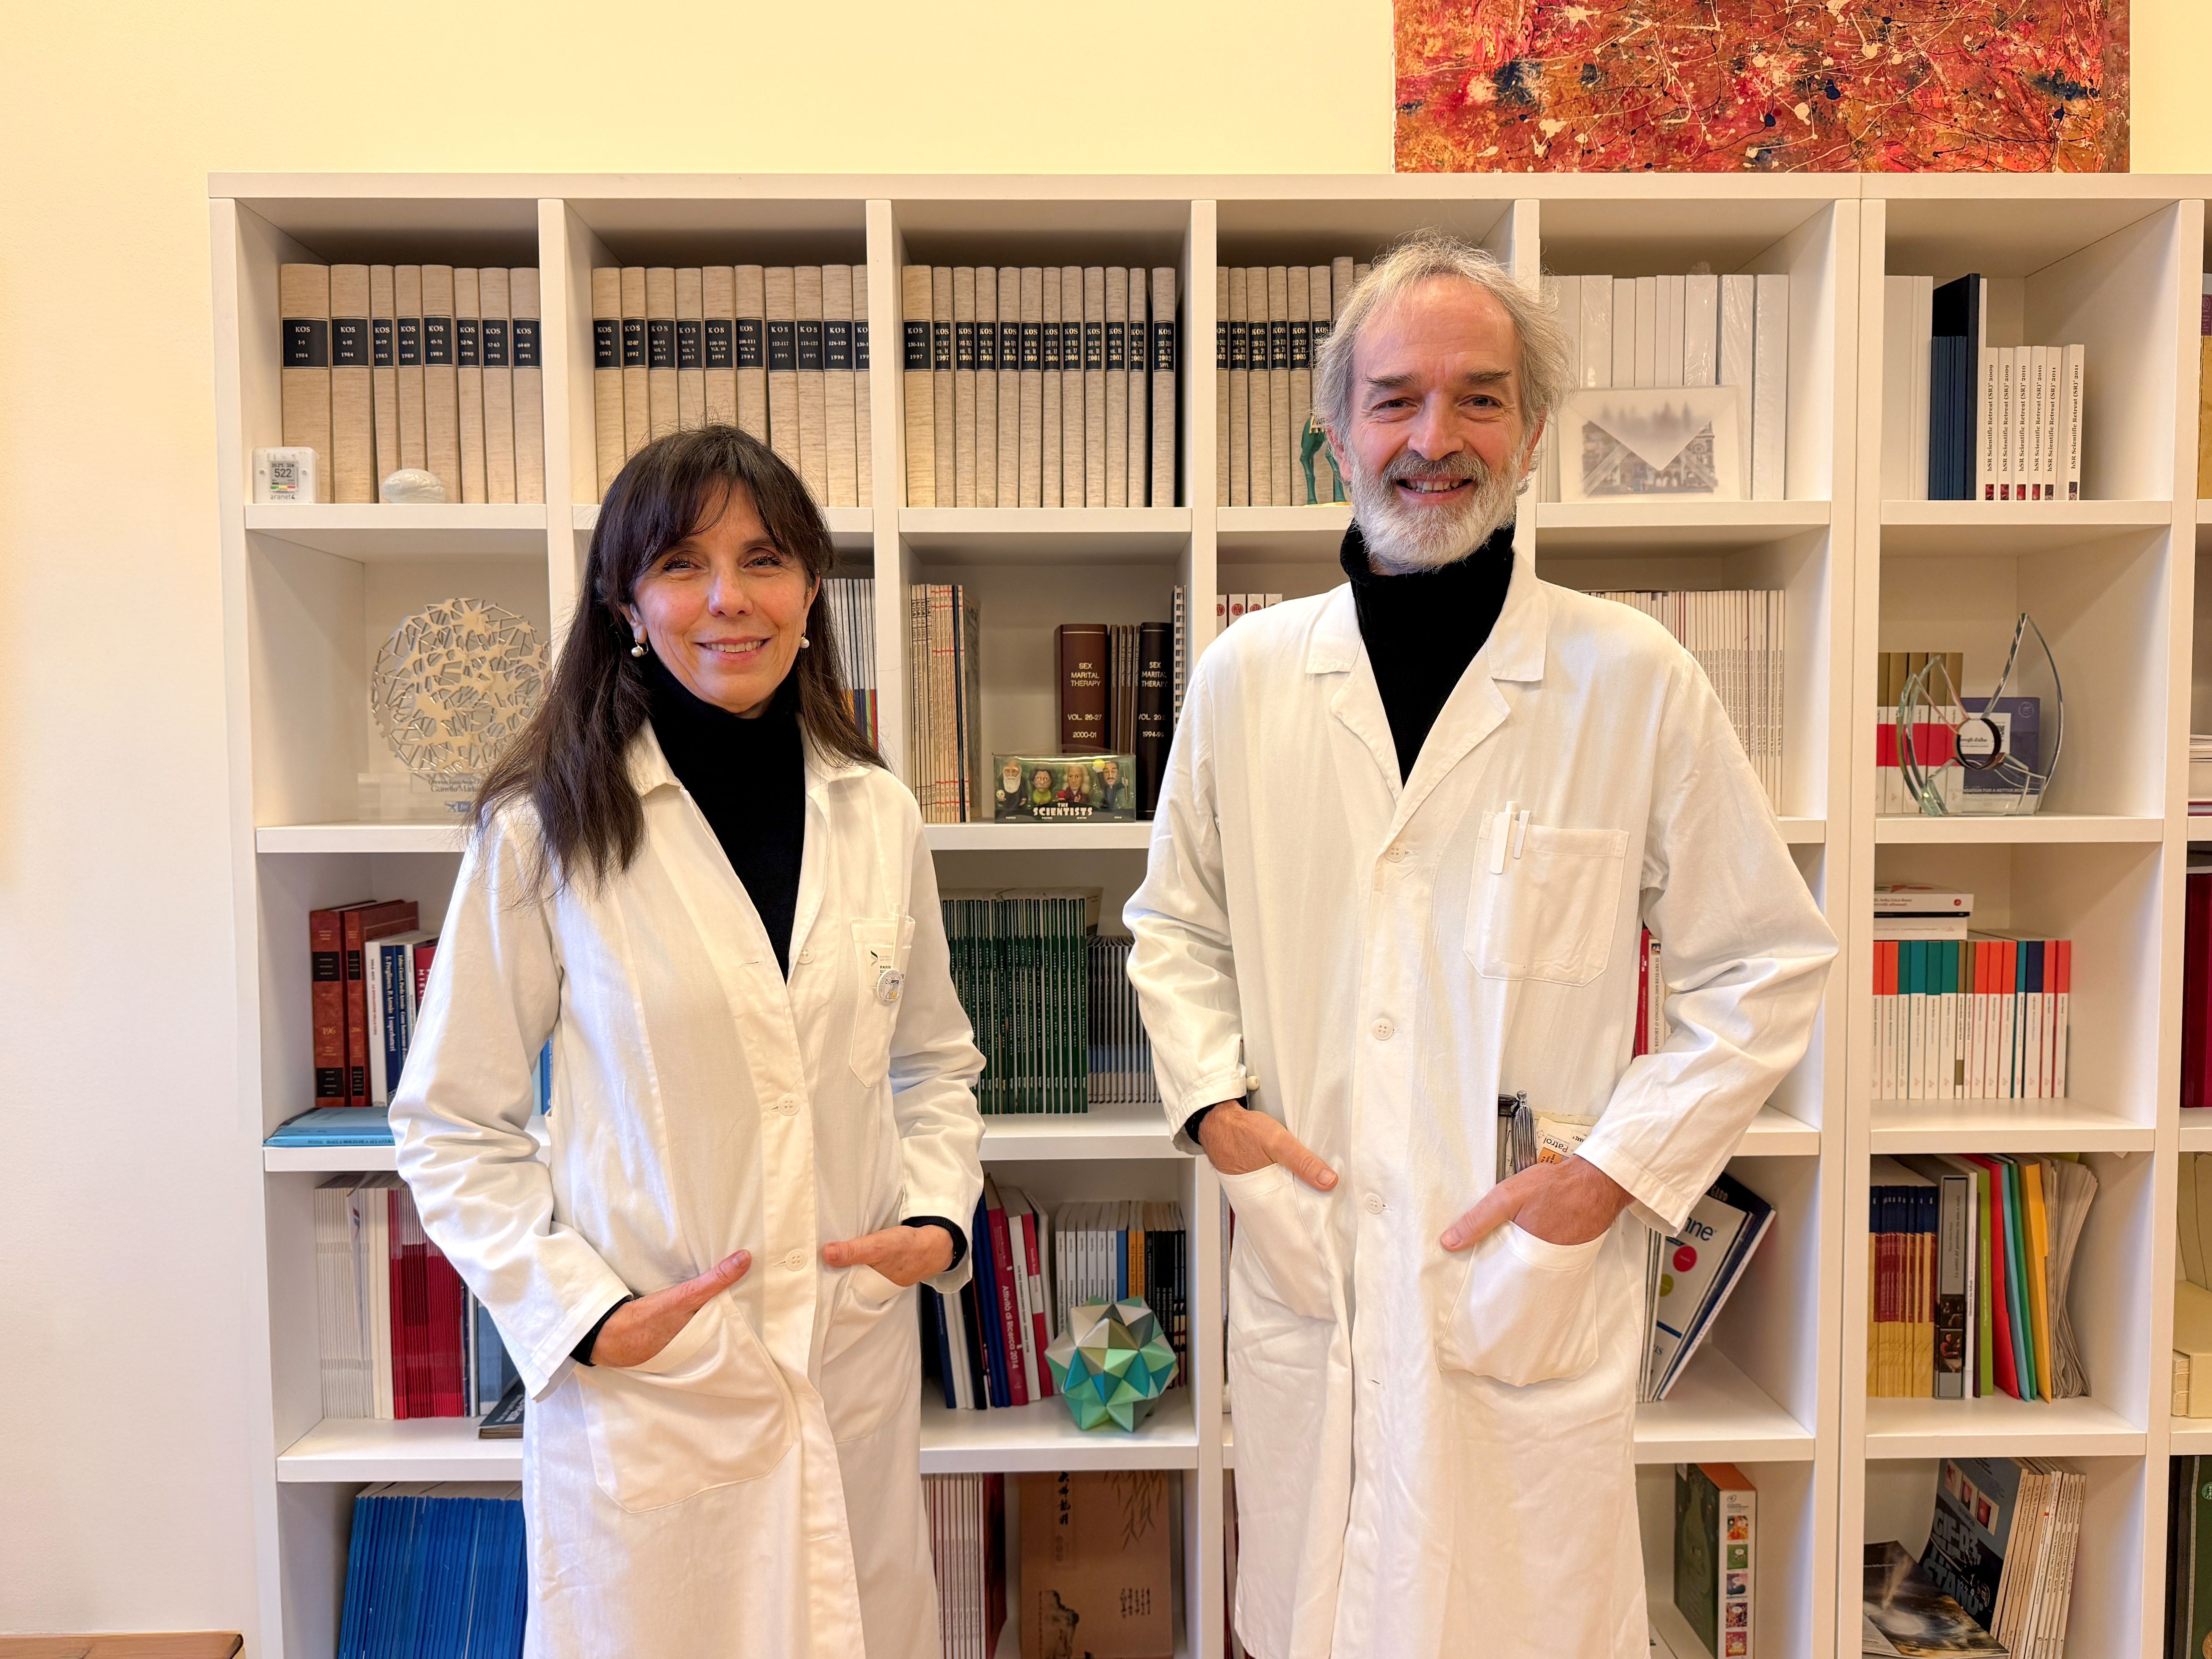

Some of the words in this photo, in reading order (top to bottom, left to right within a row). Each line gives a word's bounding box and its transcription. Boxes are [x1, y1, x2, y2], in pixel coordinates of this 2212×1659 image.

[275, 469, 291, 477] 522
[1033, 807, 1093, 816] SCIENTISTS
[1543, 1137, 1569, 1153] Patrol
[1002, 1286, 1012, 1310] Attività
[1007, 1321, 1016, 1349] Ricerca
